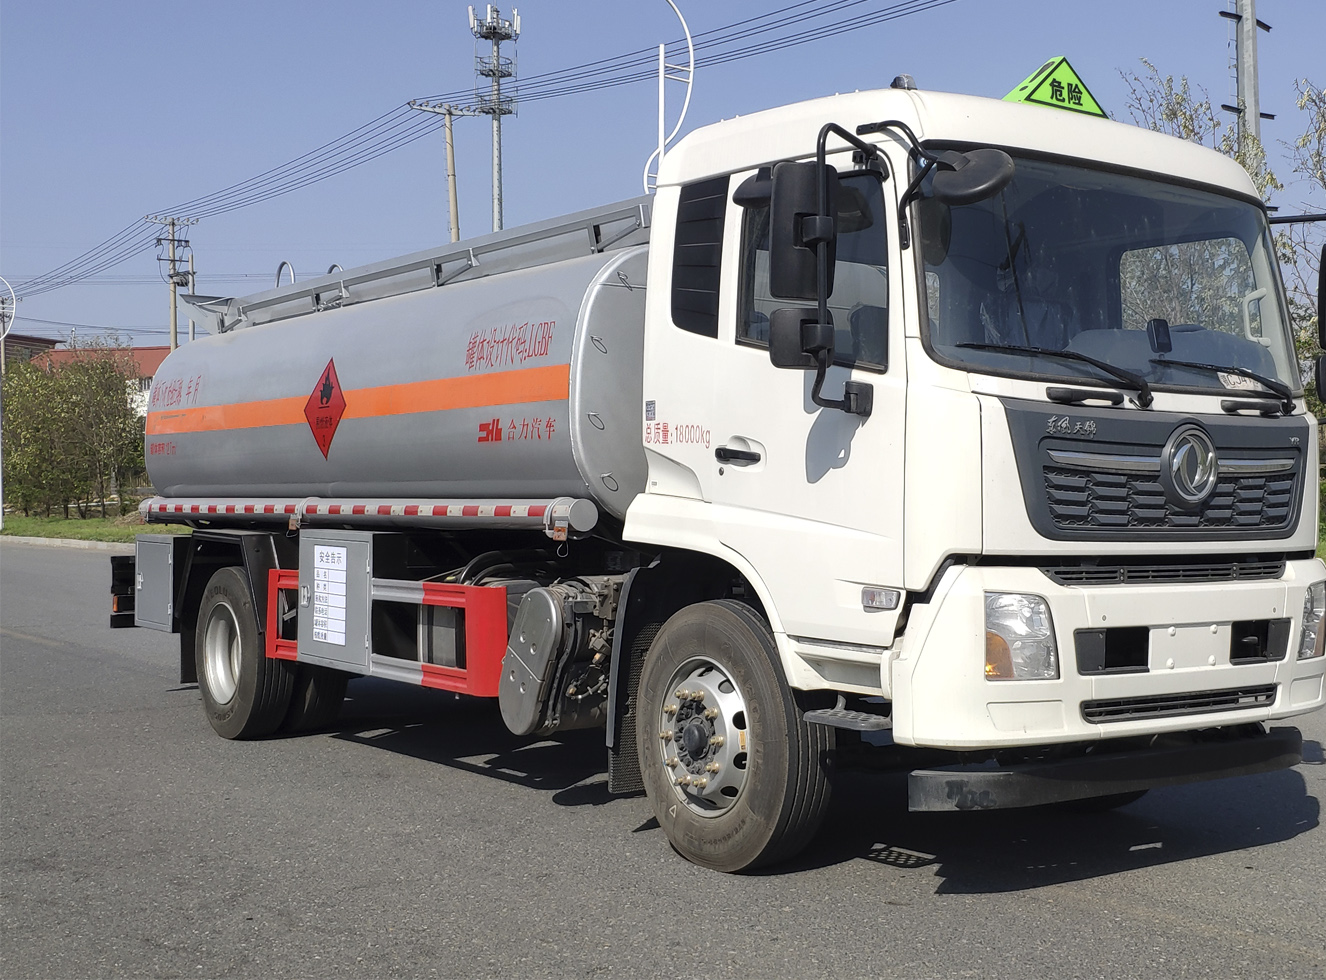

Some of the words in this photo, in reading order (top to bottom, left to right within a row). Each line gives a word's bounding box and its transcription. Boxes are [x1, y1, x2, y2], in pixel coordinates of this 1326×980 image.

[1049, 78, 1083, 106] 危险
[507, 417, 556, 441] 合力汽车
[1046, 415, 1097, 439] 东风天锦
[319, 551, 342, 565] 安全告示
